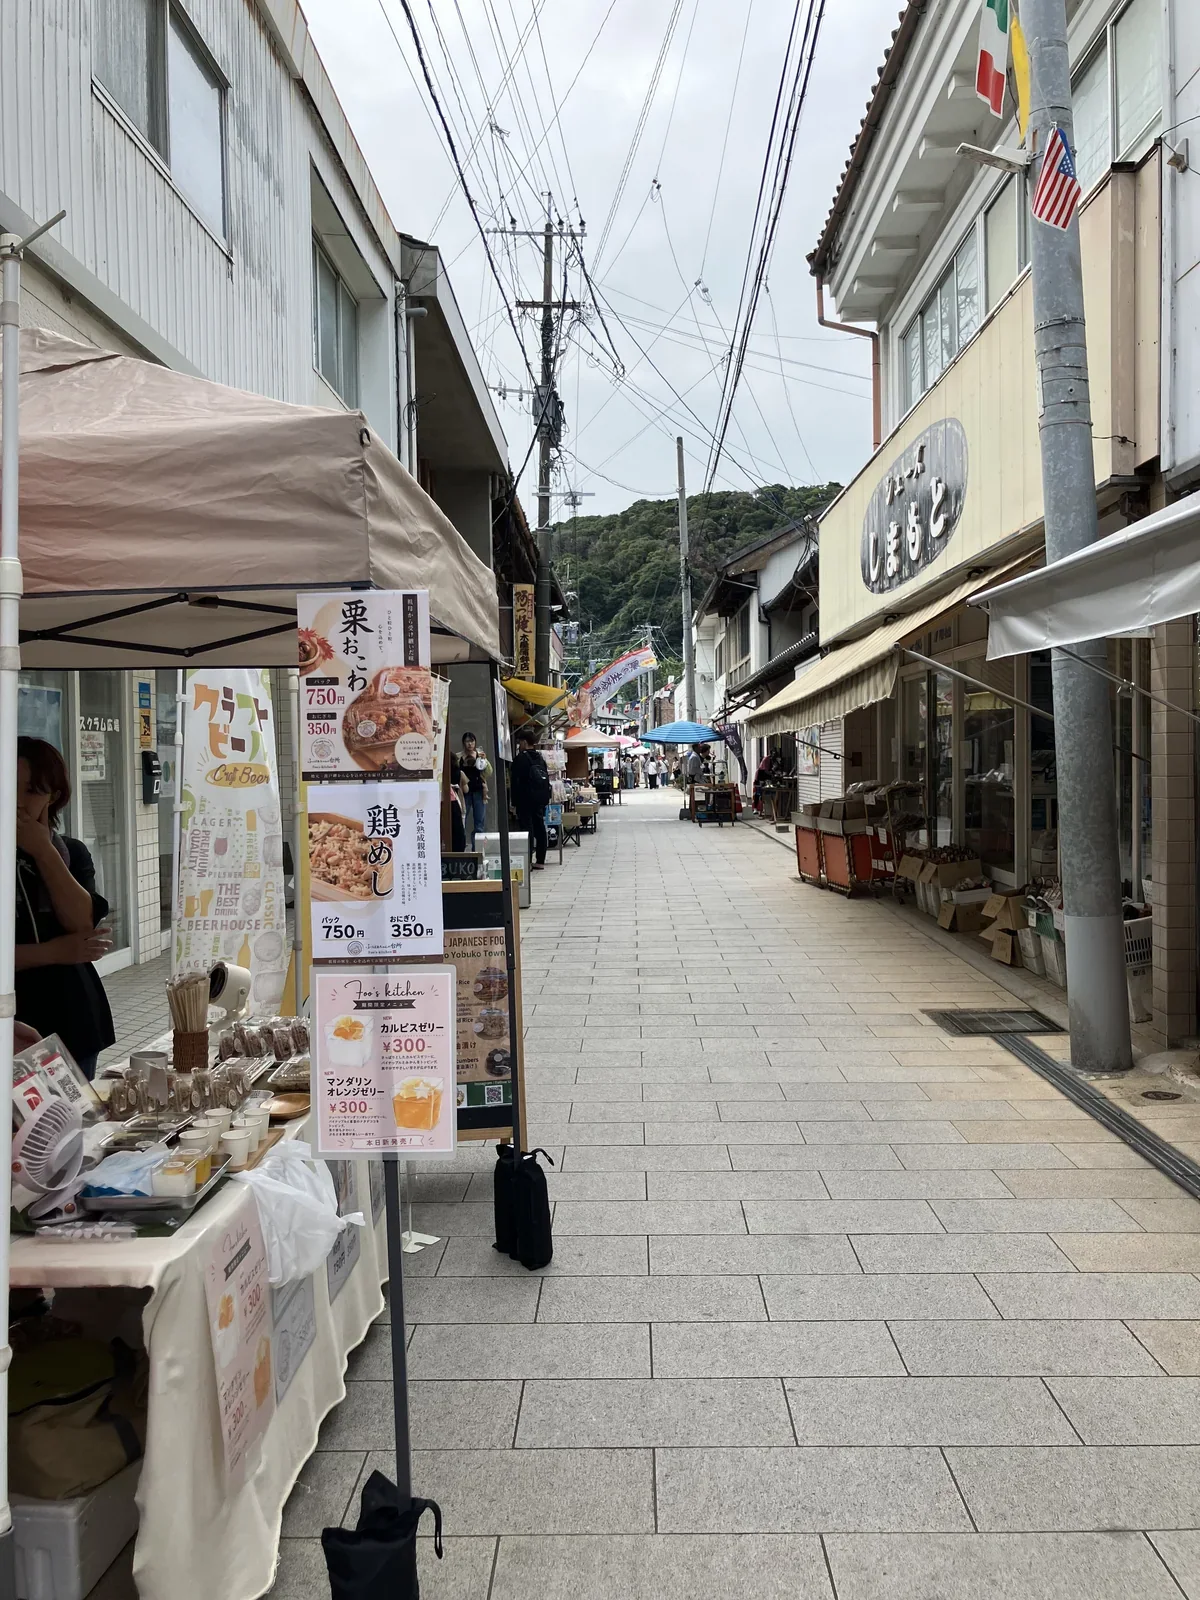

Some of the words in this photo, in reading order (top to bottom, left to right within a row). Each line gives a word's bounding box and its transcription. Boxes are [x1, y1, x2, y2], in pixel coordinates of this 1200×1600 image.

[869, 476, 948, 582] しまもと
[339, 599, 375, 692] 栗おこわ
[306, 688, 345, 705] 750円
[193, 683, 268, 732] クラフト
[79, 716, 120, 732] スクラム広場
[307, 722, 337, 735] 350円
[208, 722, 268, 762] ビール
[213, 764, 239, 785] Craft
[238, 766, 270, 784] Beer
[192, 817, 232, 828] LAGER
[416, 809, 426, 859] 旨み熟成親鶏
[188, 828, 201, 872] QUALITY
[196, 830, 211, 878] PREMIUM
[366, 804, 401, 897] 鶏めし
[208, 870, 242, 878] PILSNER
[442, 861, 475, 875] BUKO
[218, 883, 240, 895] THE
[216, 898, 239, 907] BEST
[263, 881, 275, 929] CLASSIC
[214, 908, 238, 916] DRINK
[187, 919, 261, 931] BEERHOUSE
[322, 924, 365, 939] 750円
[391, 923, 434, 937] 350円
[449, 936, 488, 947] JAPANESE
[489, 935, 505, 946] FOO
[451, 950, 481, 959] Yobuko
[344, 980, 380, 1000] Foo's
[384, 980, 425, 997] kitchen
[380, 1022, 444, 1033] カルピスゼリー
[326, 1077, 372, 1087] マンダリン
[327, 1087, 385, 1097] オレンジゼリー
[366, 1137, 413, 1146] 本日新発売！
